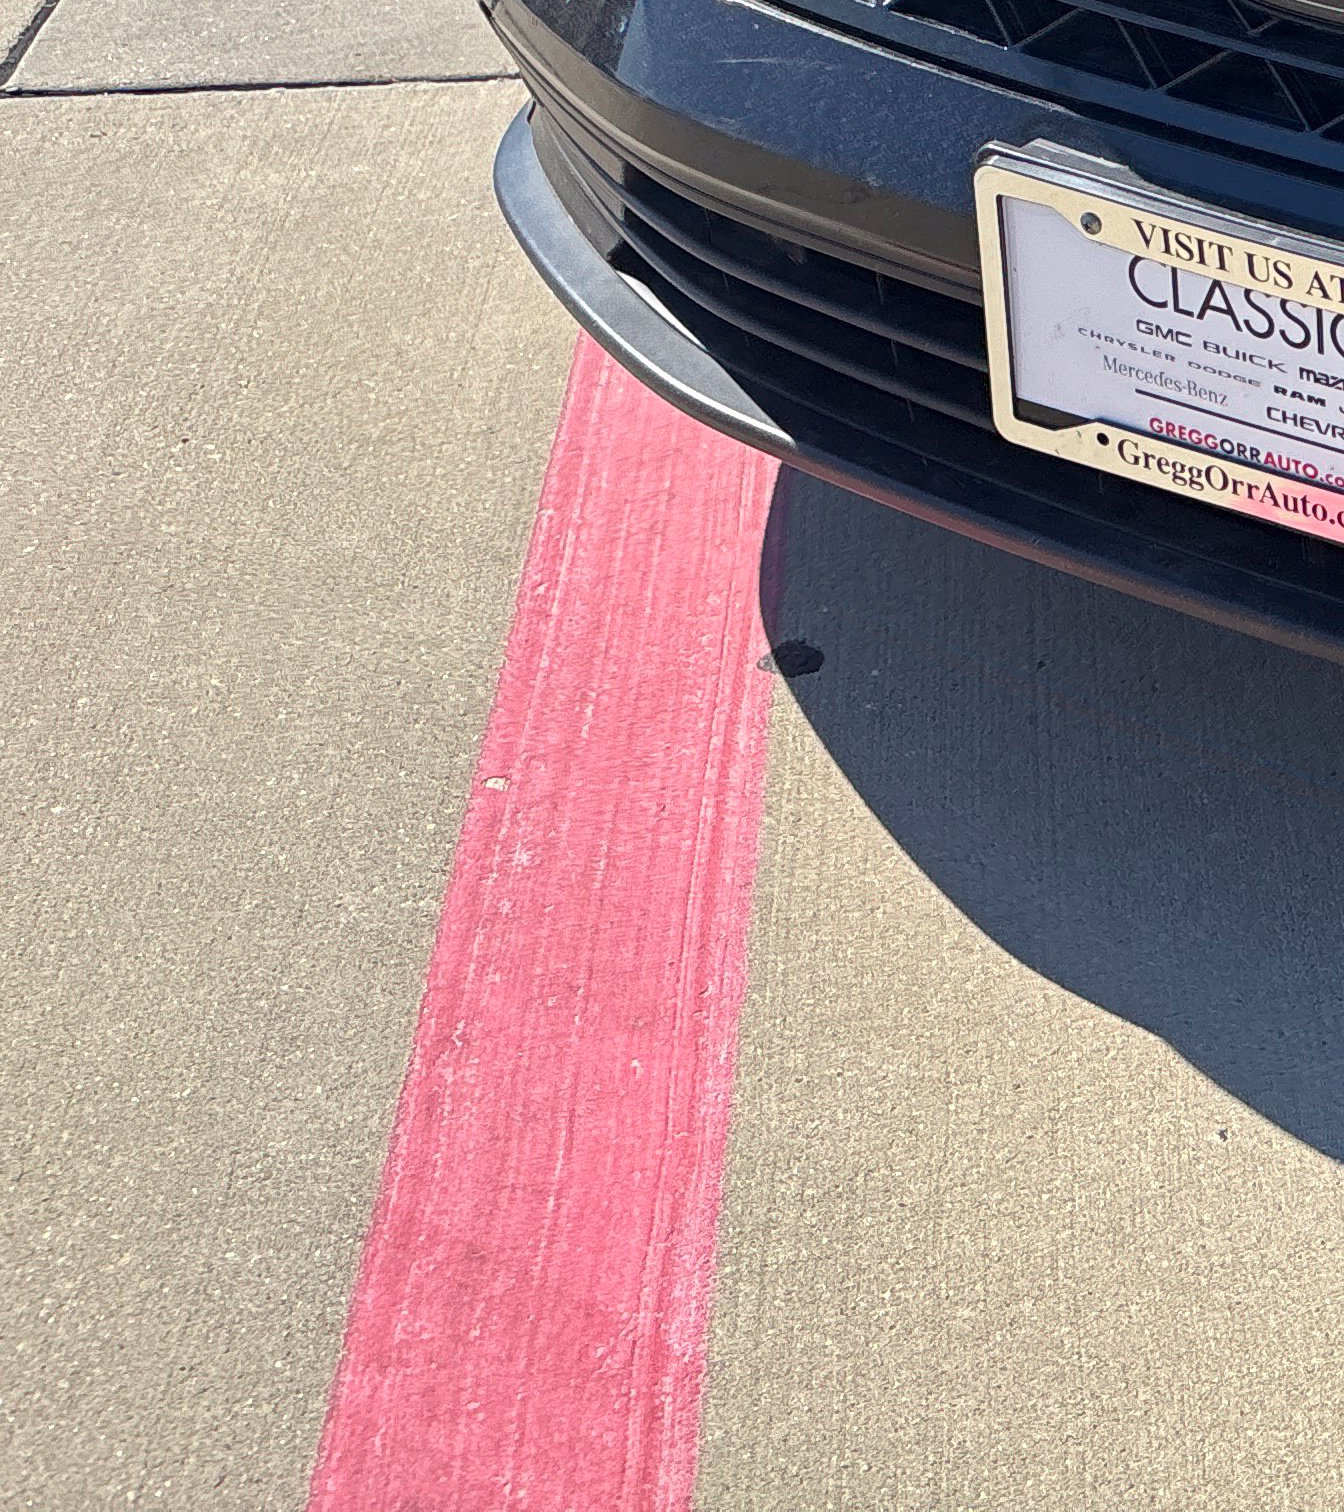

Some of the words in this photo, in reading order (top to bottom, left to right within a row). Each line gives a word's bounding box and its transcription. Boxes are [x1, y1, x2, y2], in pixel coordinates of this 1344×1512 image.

[1131, 218, 1234, 273] VISIT
[1243, 251, 1295, 290] US
[1077, 326, 1177, 363] CHRYSLER
[1187, 359, 1262, 388] DODGE
[1273, 384, 1328, 408] RAM
[1135, 318, 1194, 348] GMC
[1202, 339, 1289, 374] BUICK
[1101, 353, 1230, 408] Mercedes-Benz
